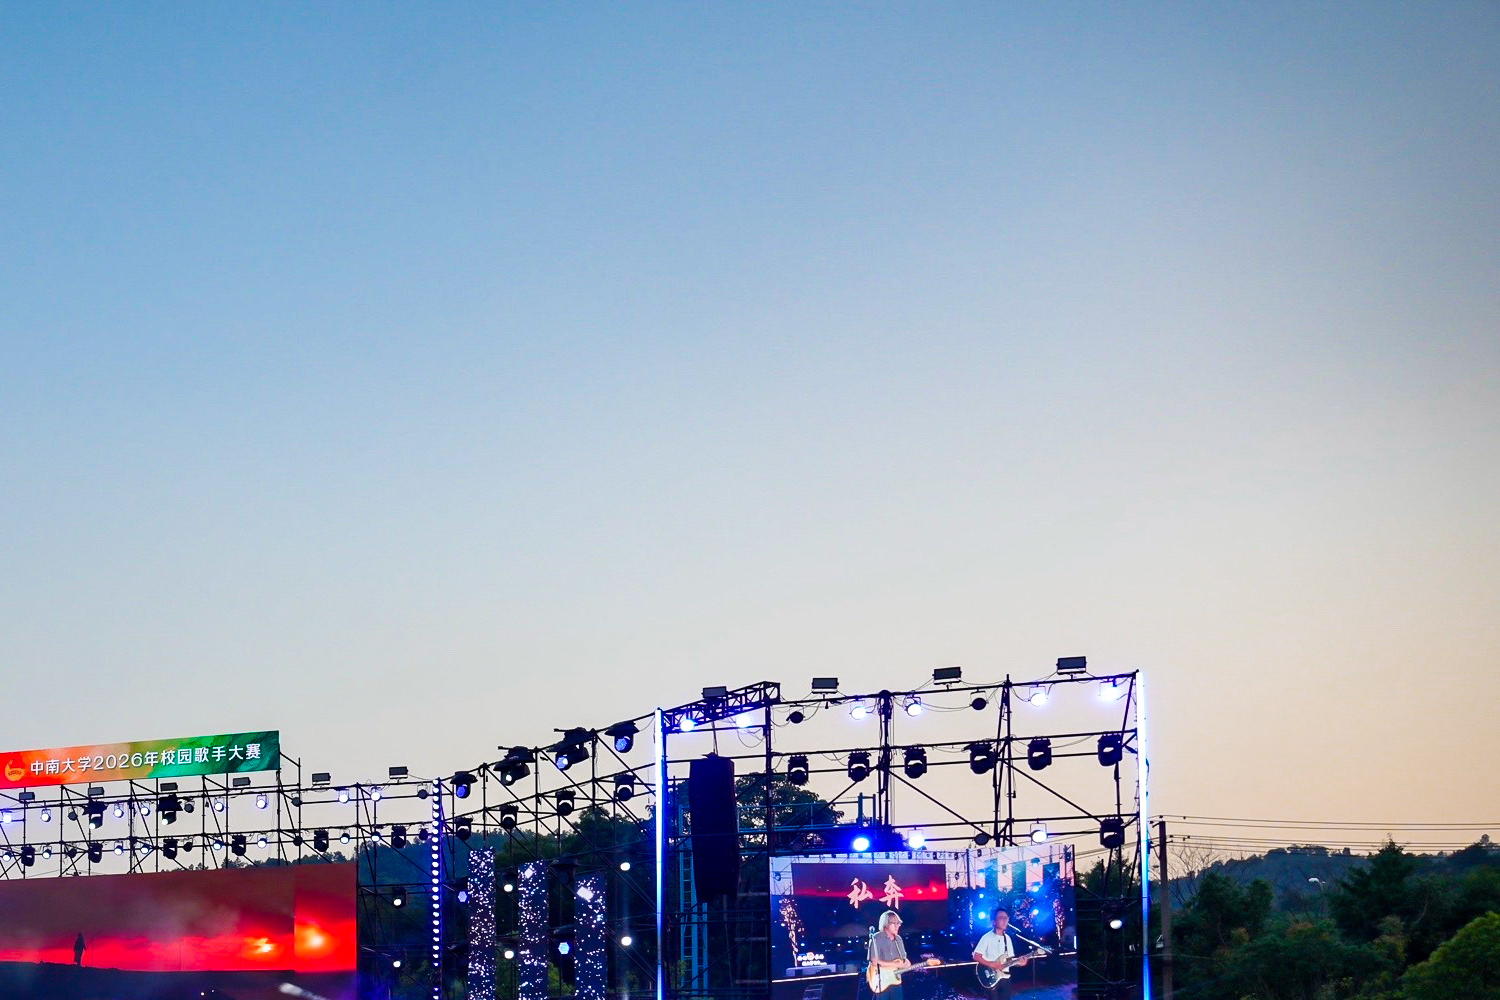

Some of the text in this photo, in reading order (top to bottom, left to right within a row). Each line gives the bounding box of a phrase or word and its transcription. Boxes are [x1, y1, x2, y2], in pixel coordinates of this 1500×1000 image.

[30, 743, 261, 775] 中南大学2026年校园歌手大赛
[847, 874, 904, 910] 私奔
